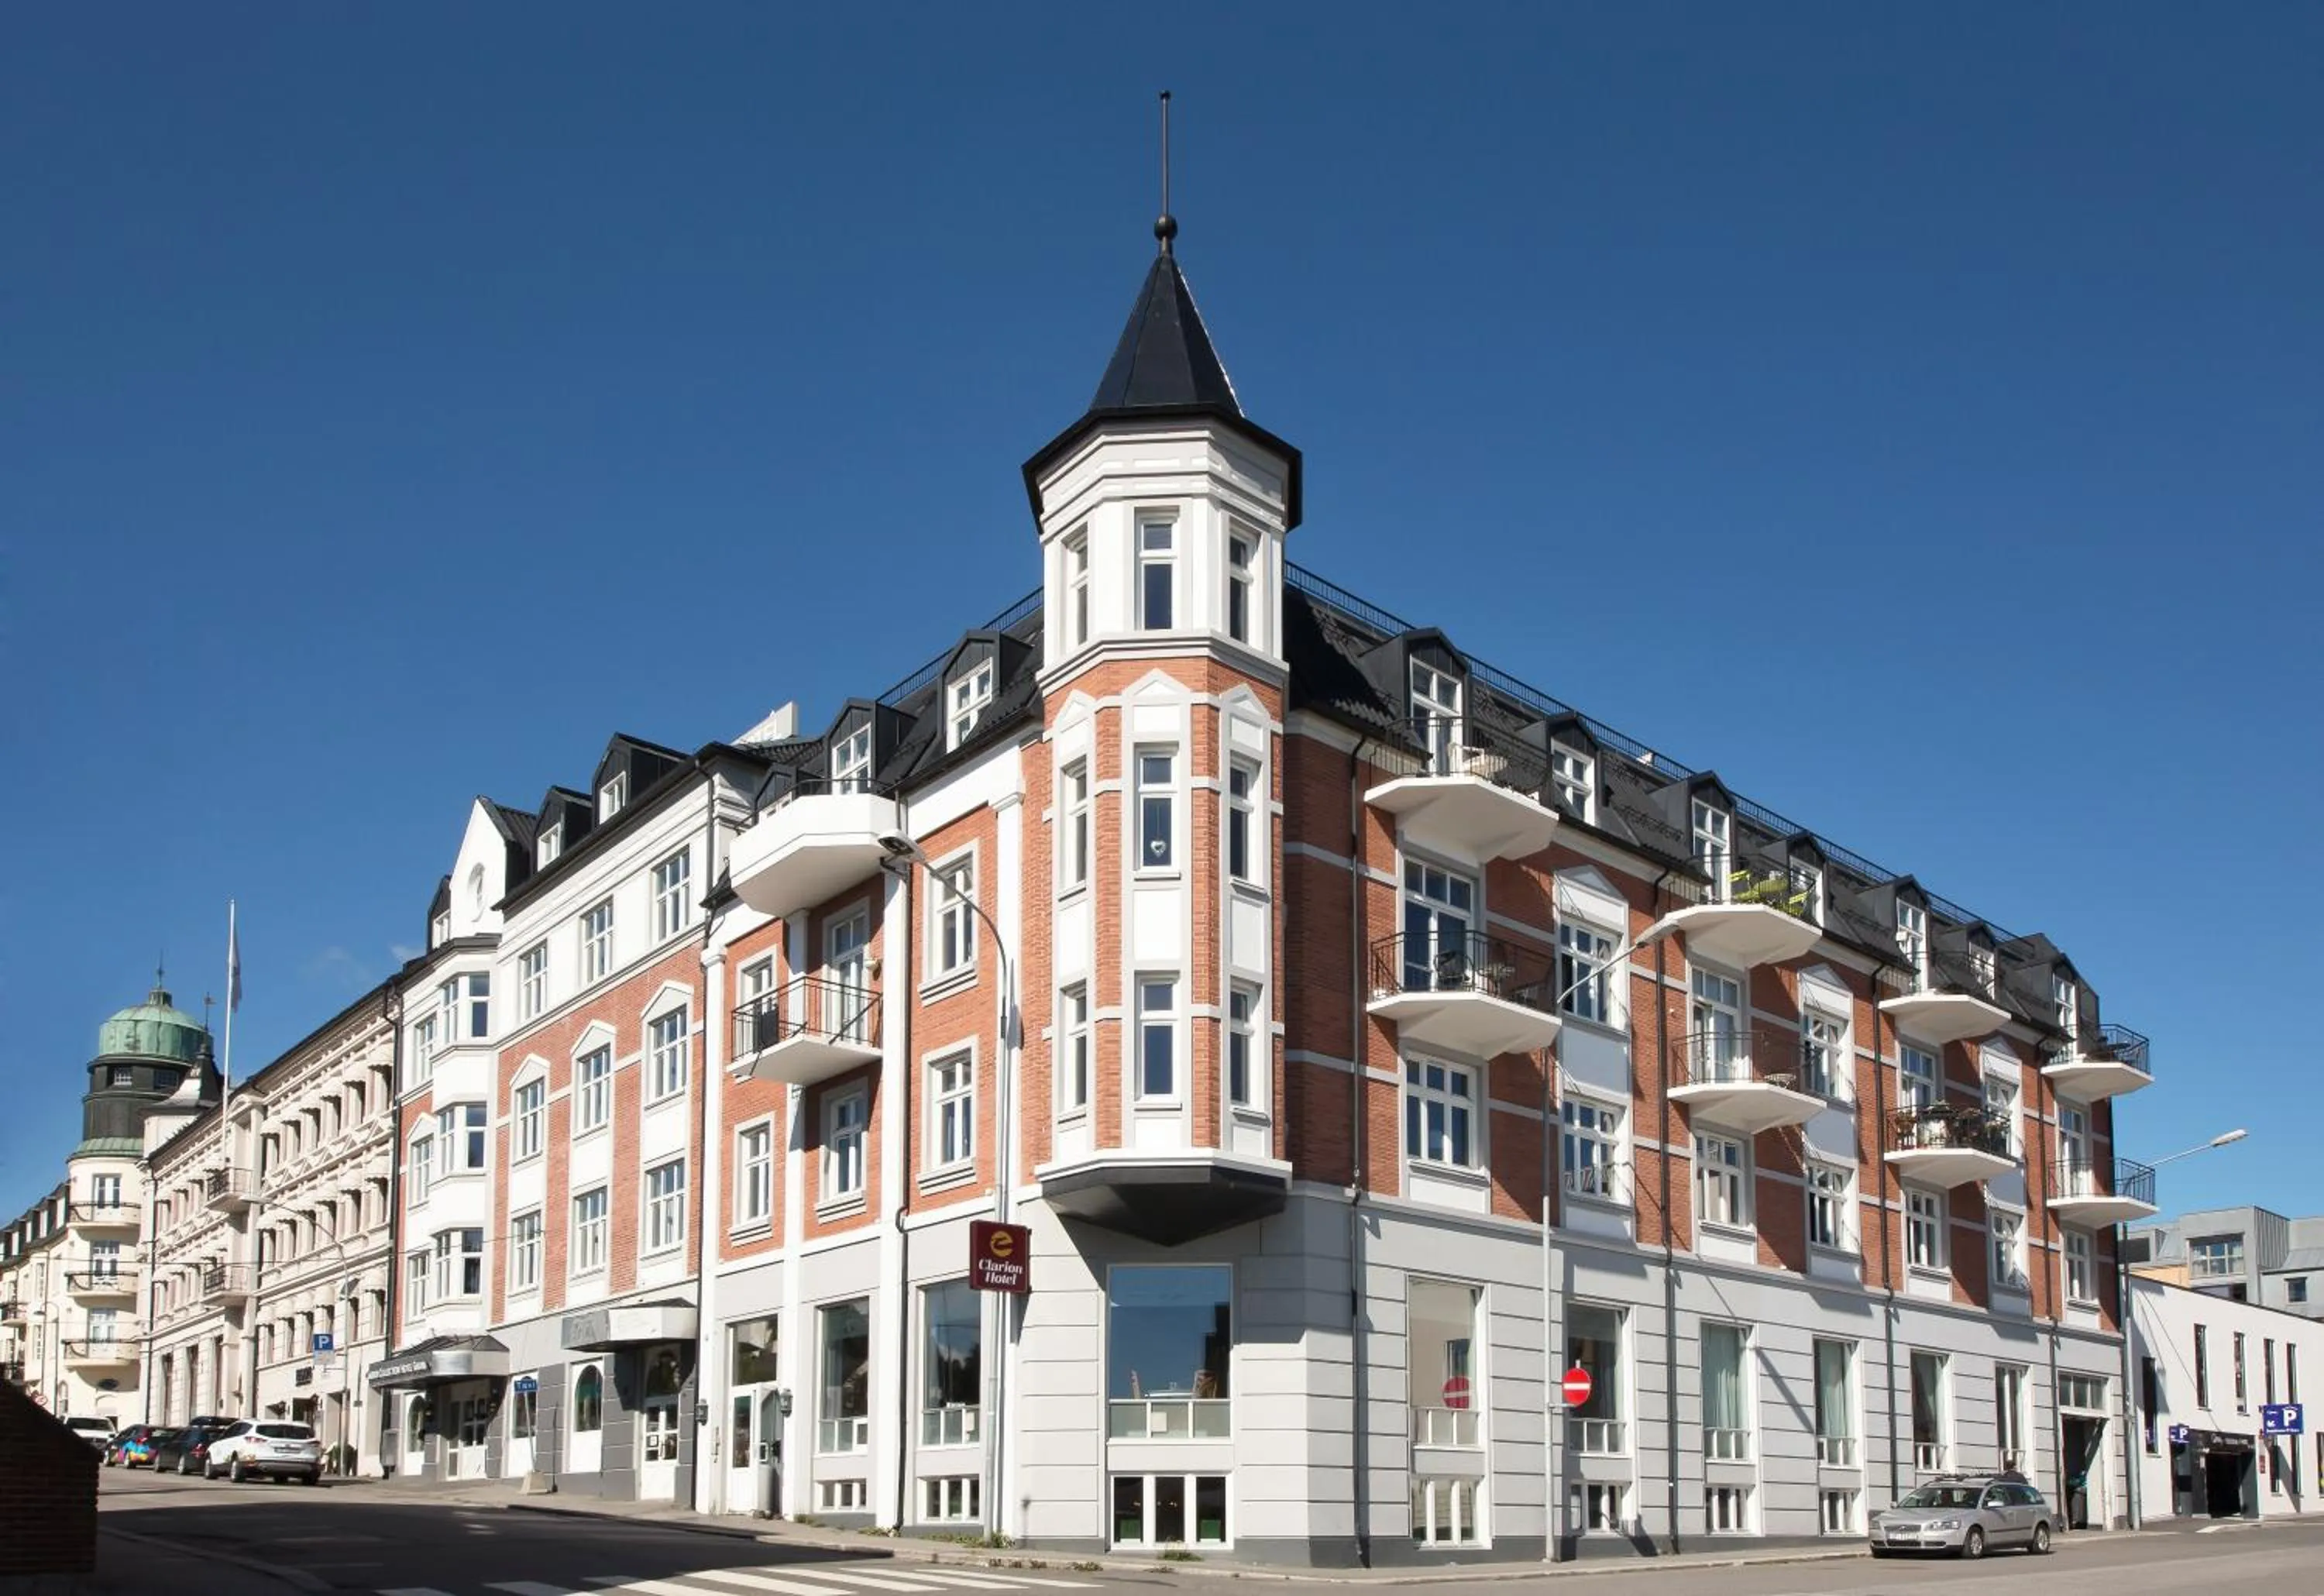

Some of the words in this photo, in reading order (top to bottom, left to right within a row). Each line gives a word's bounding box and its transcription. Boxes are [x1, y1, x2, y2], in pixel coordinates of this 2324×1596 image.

[978, 1259, 1022, 1274] Clarion
[985, 1272, 1016, 1285] Hotel
[318, 1335, 329, 1349] P
[2283, 1409, 2297, 1427] P
[2178, 1427, 2188, 1439] P
